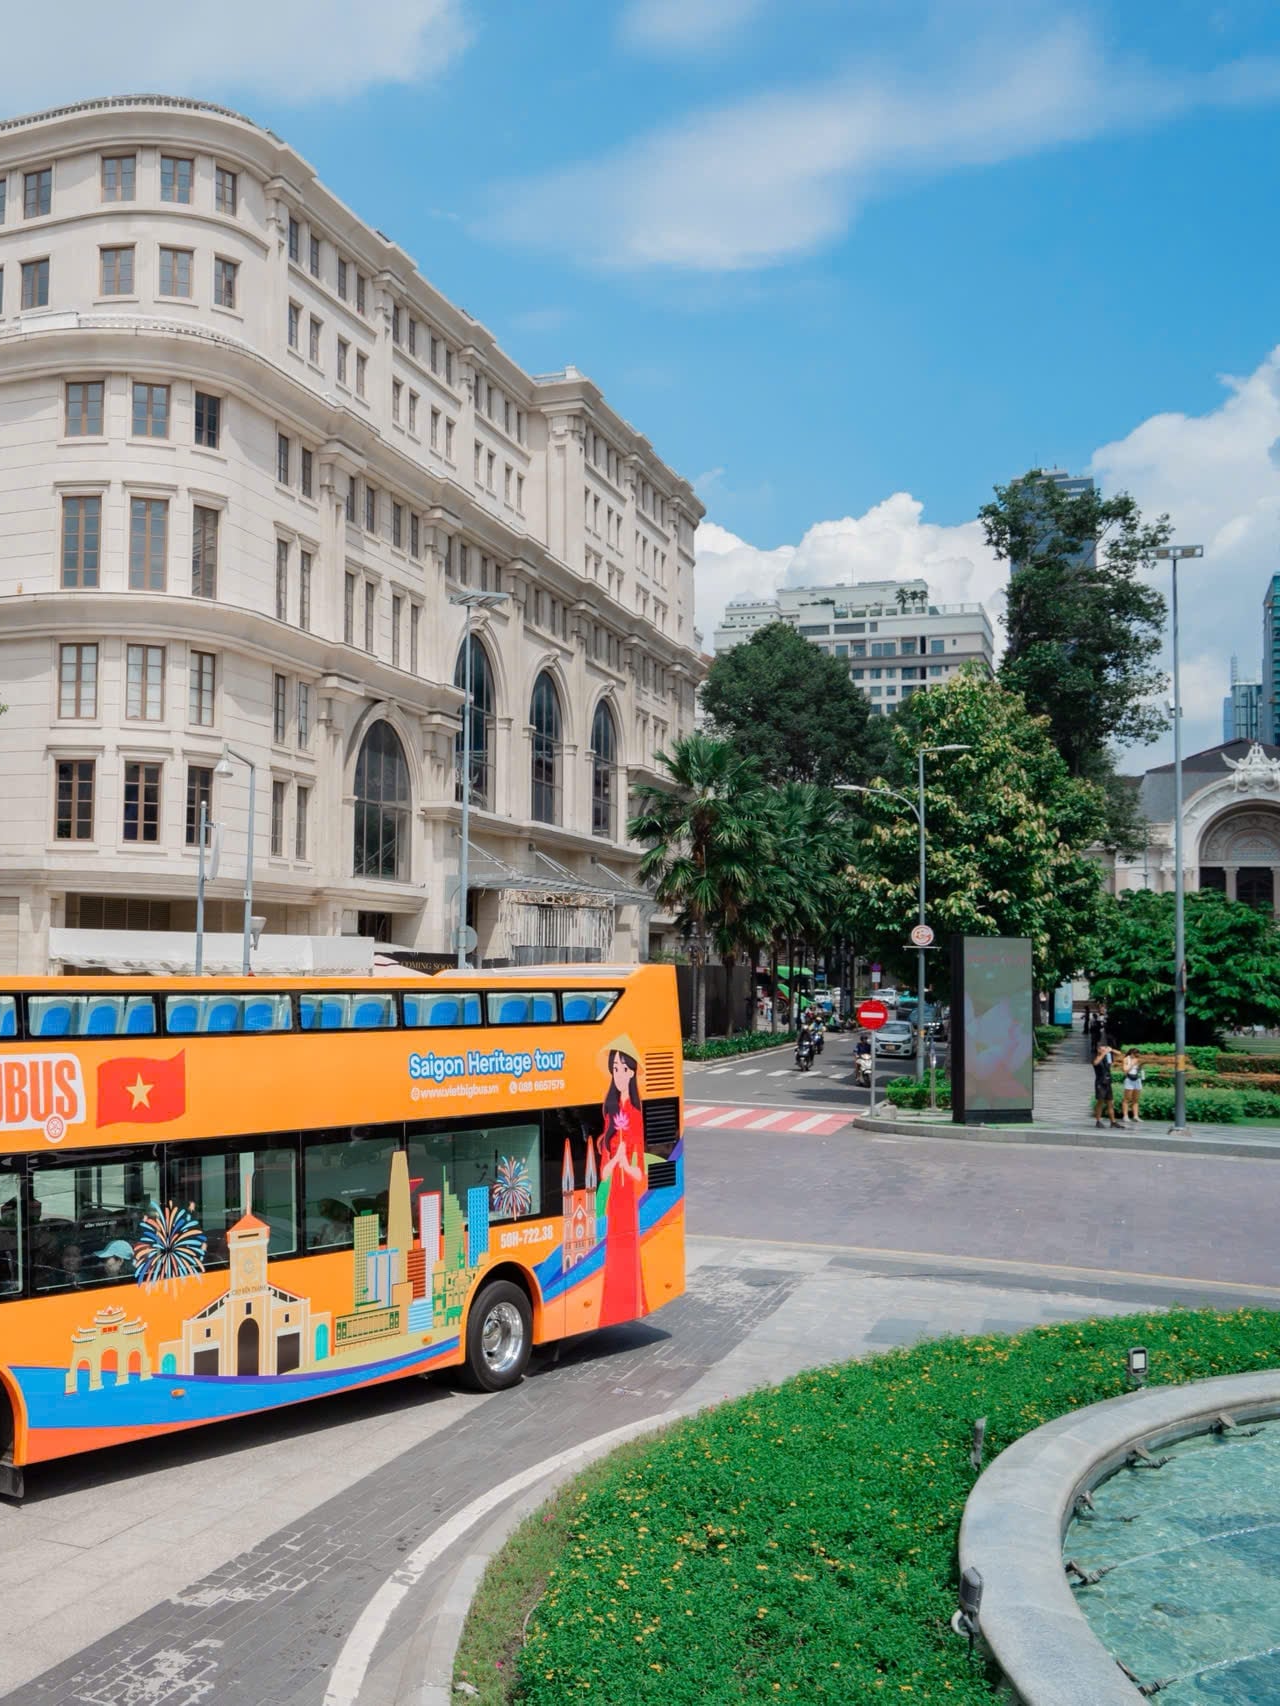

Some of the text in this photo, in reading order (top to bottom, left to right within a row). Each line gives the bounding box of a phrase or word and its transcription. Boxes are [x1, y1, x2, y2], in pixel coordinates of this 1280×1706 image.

[400, 961, 455, 970] COMING SOON
[409, 1049, 565, 1082] Saigon Heritage tour
